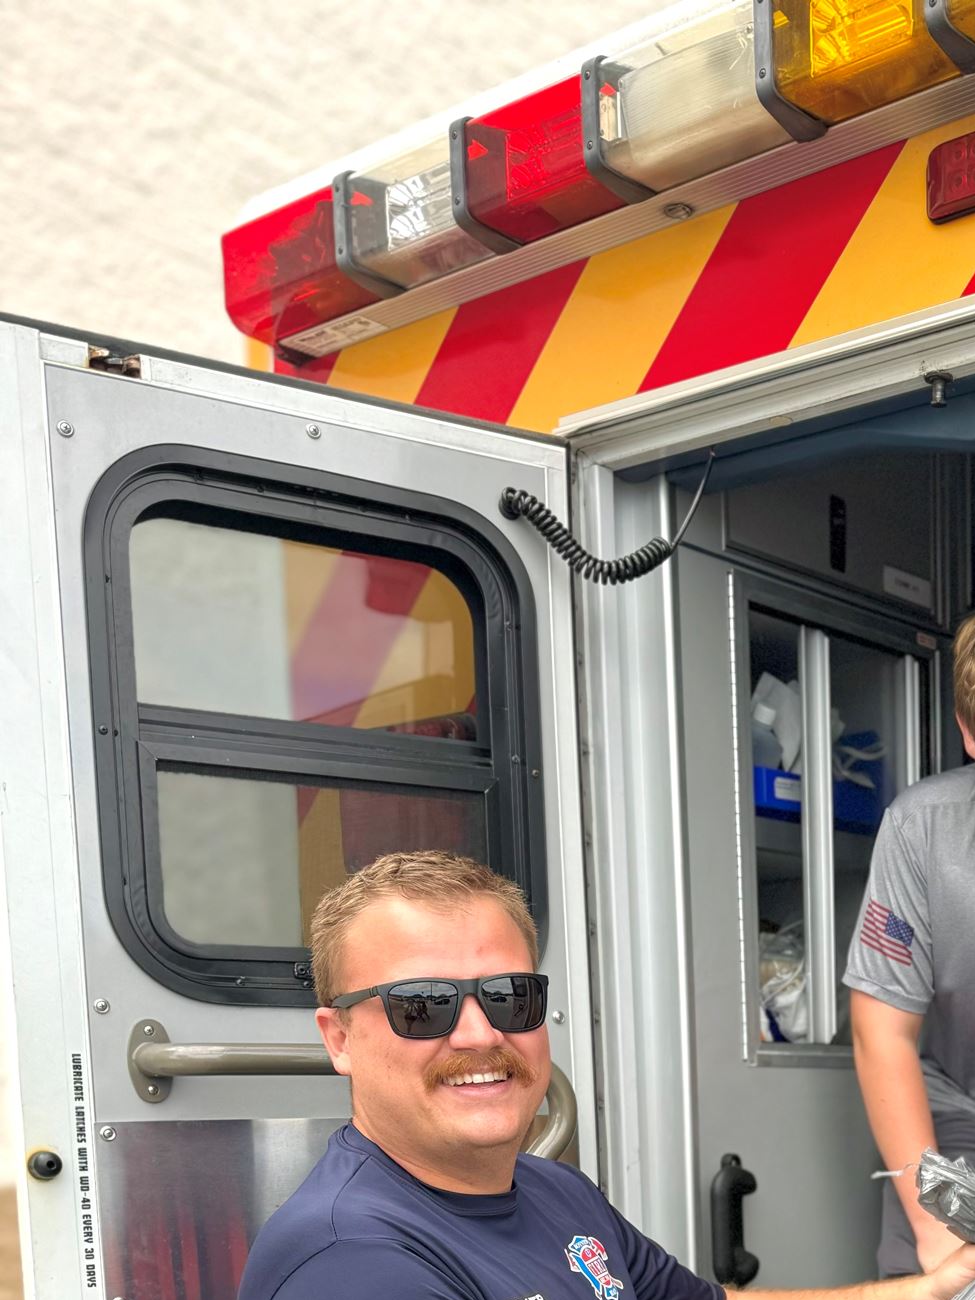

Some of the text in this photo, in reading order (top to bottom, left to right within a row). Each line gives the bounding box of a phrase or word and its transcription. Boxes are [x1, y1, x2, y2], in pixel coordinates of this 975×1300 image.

[71, 1053, 97, 1288] LUBRICATE LATCHES WITH WD-40 EVERY 30 DAYS
